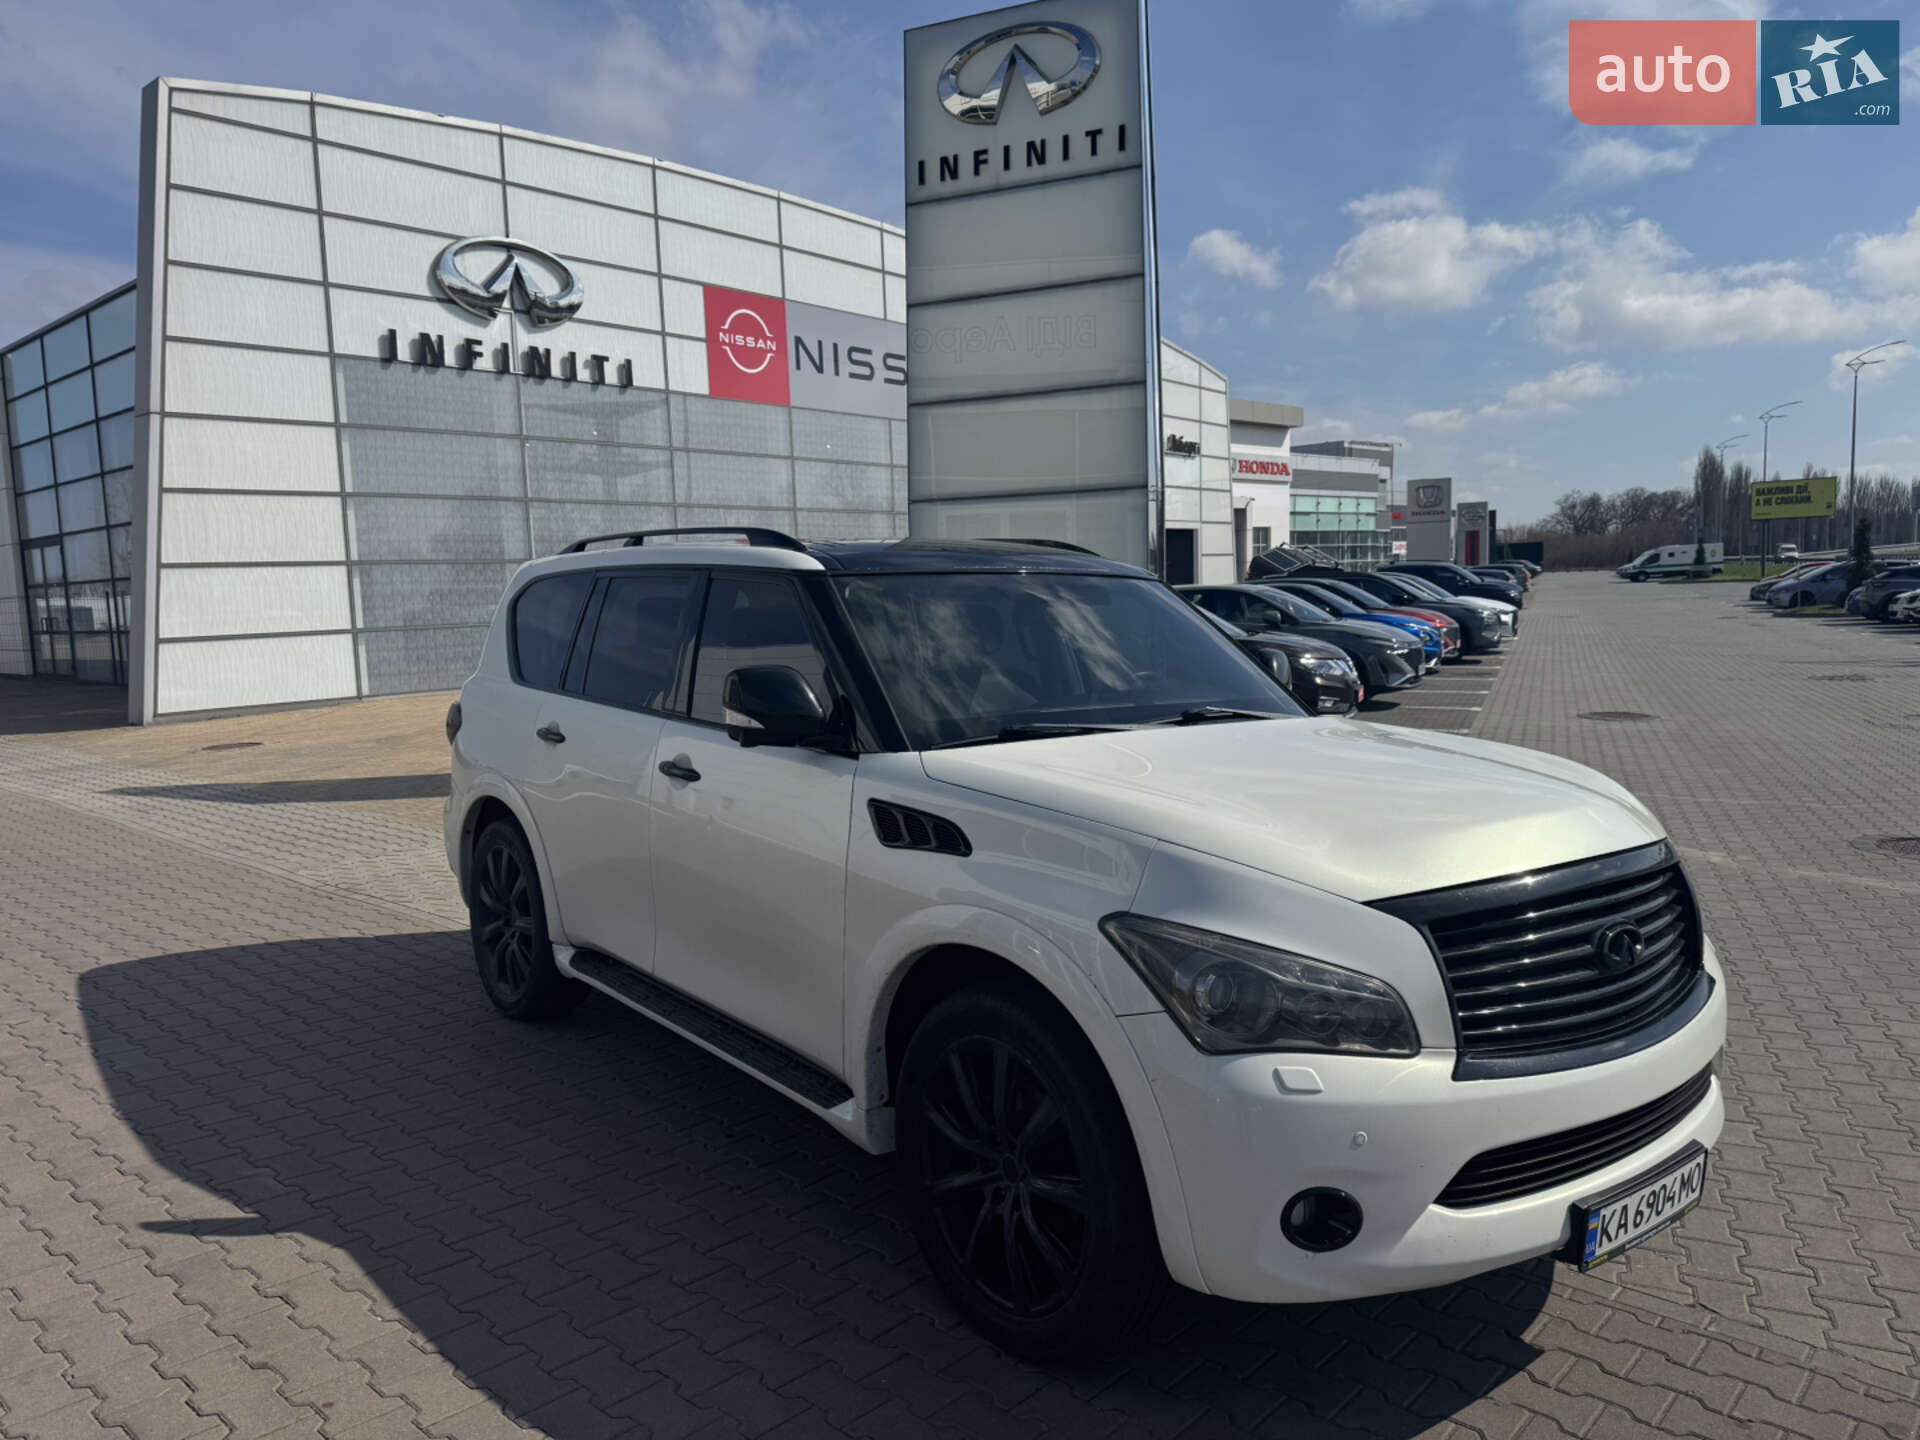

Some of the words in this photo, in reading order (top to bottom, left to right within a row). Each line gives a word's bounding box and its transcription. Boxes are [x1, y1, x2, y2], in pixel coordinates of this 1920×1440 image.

[917, 124, 1126, 186] INFINITI
[386, 328, 634, 387] INFINITI
[719, 331, 777, 351] NISSAN
[1239, 459, 1291, 476] HONDA
